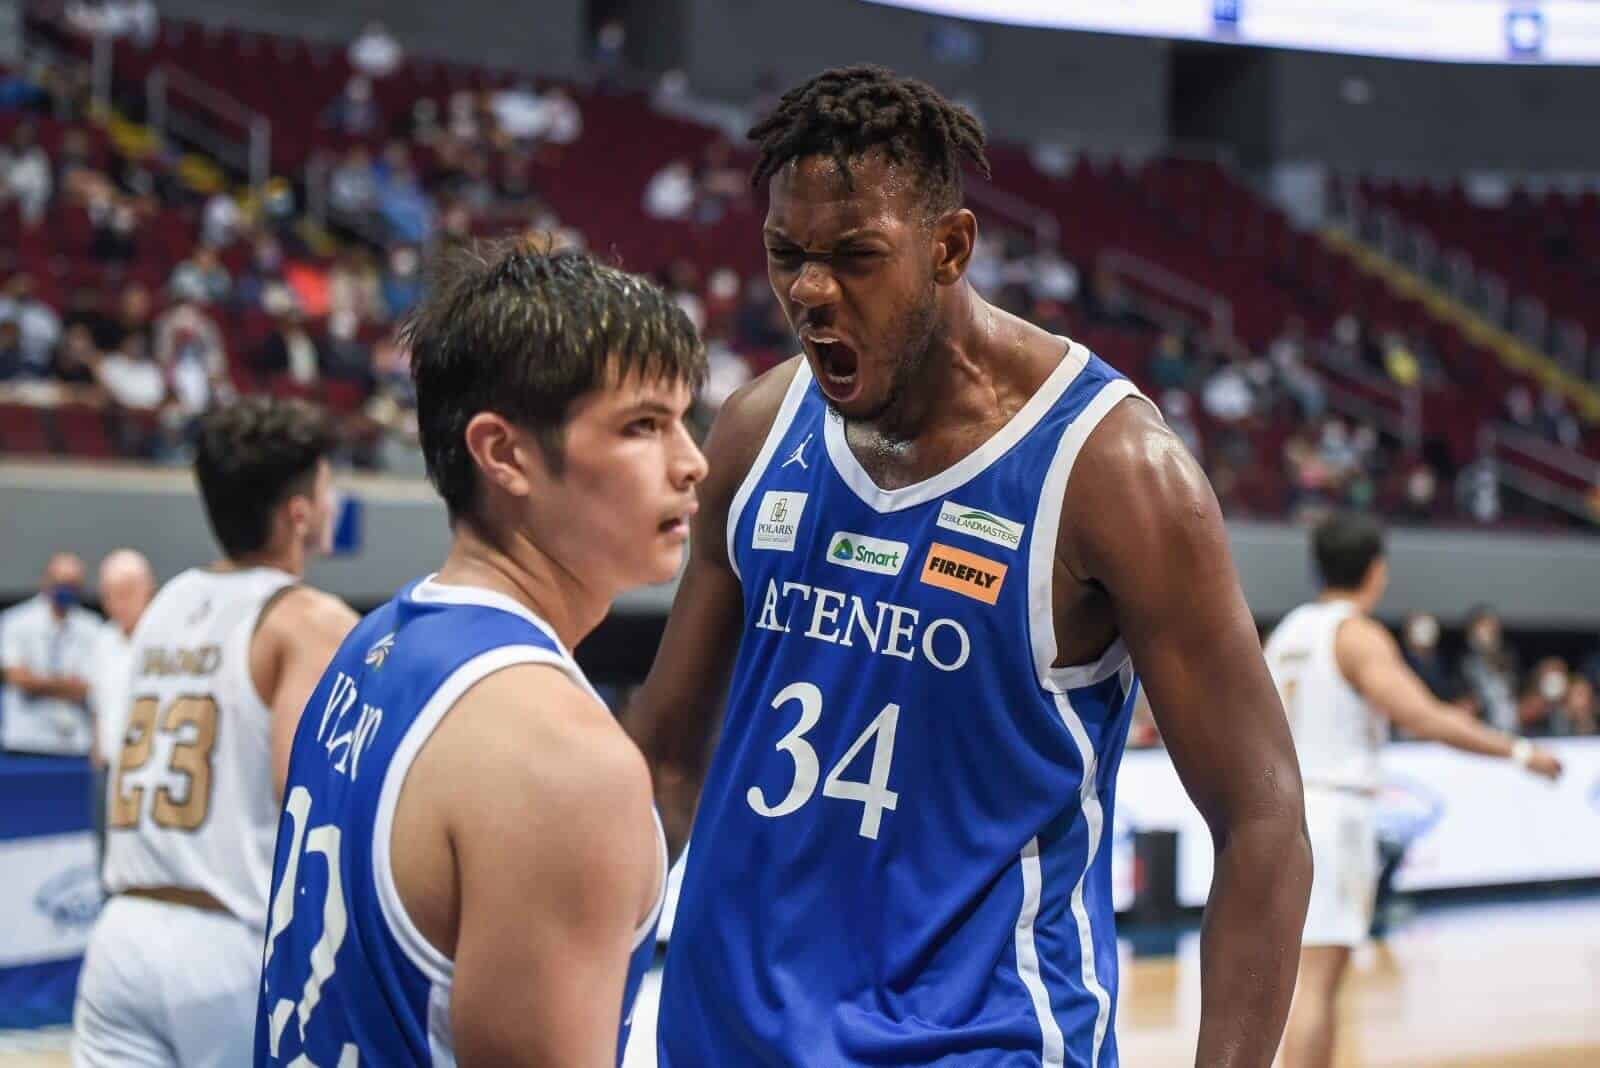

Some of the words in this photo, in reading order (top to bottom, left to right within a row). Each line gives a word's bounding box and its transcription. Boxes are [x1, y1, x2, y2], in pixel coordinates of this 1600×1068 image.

[758, 523, 794, 536] POLARIS
[855, 544, 899, 569] Smart
[928, 556, 1001, 590] FIREFLY
[755, 576, 971, 672] ATENEO
[107, 693, 222, 832] 23
[746, 681, 901, 841] 34
